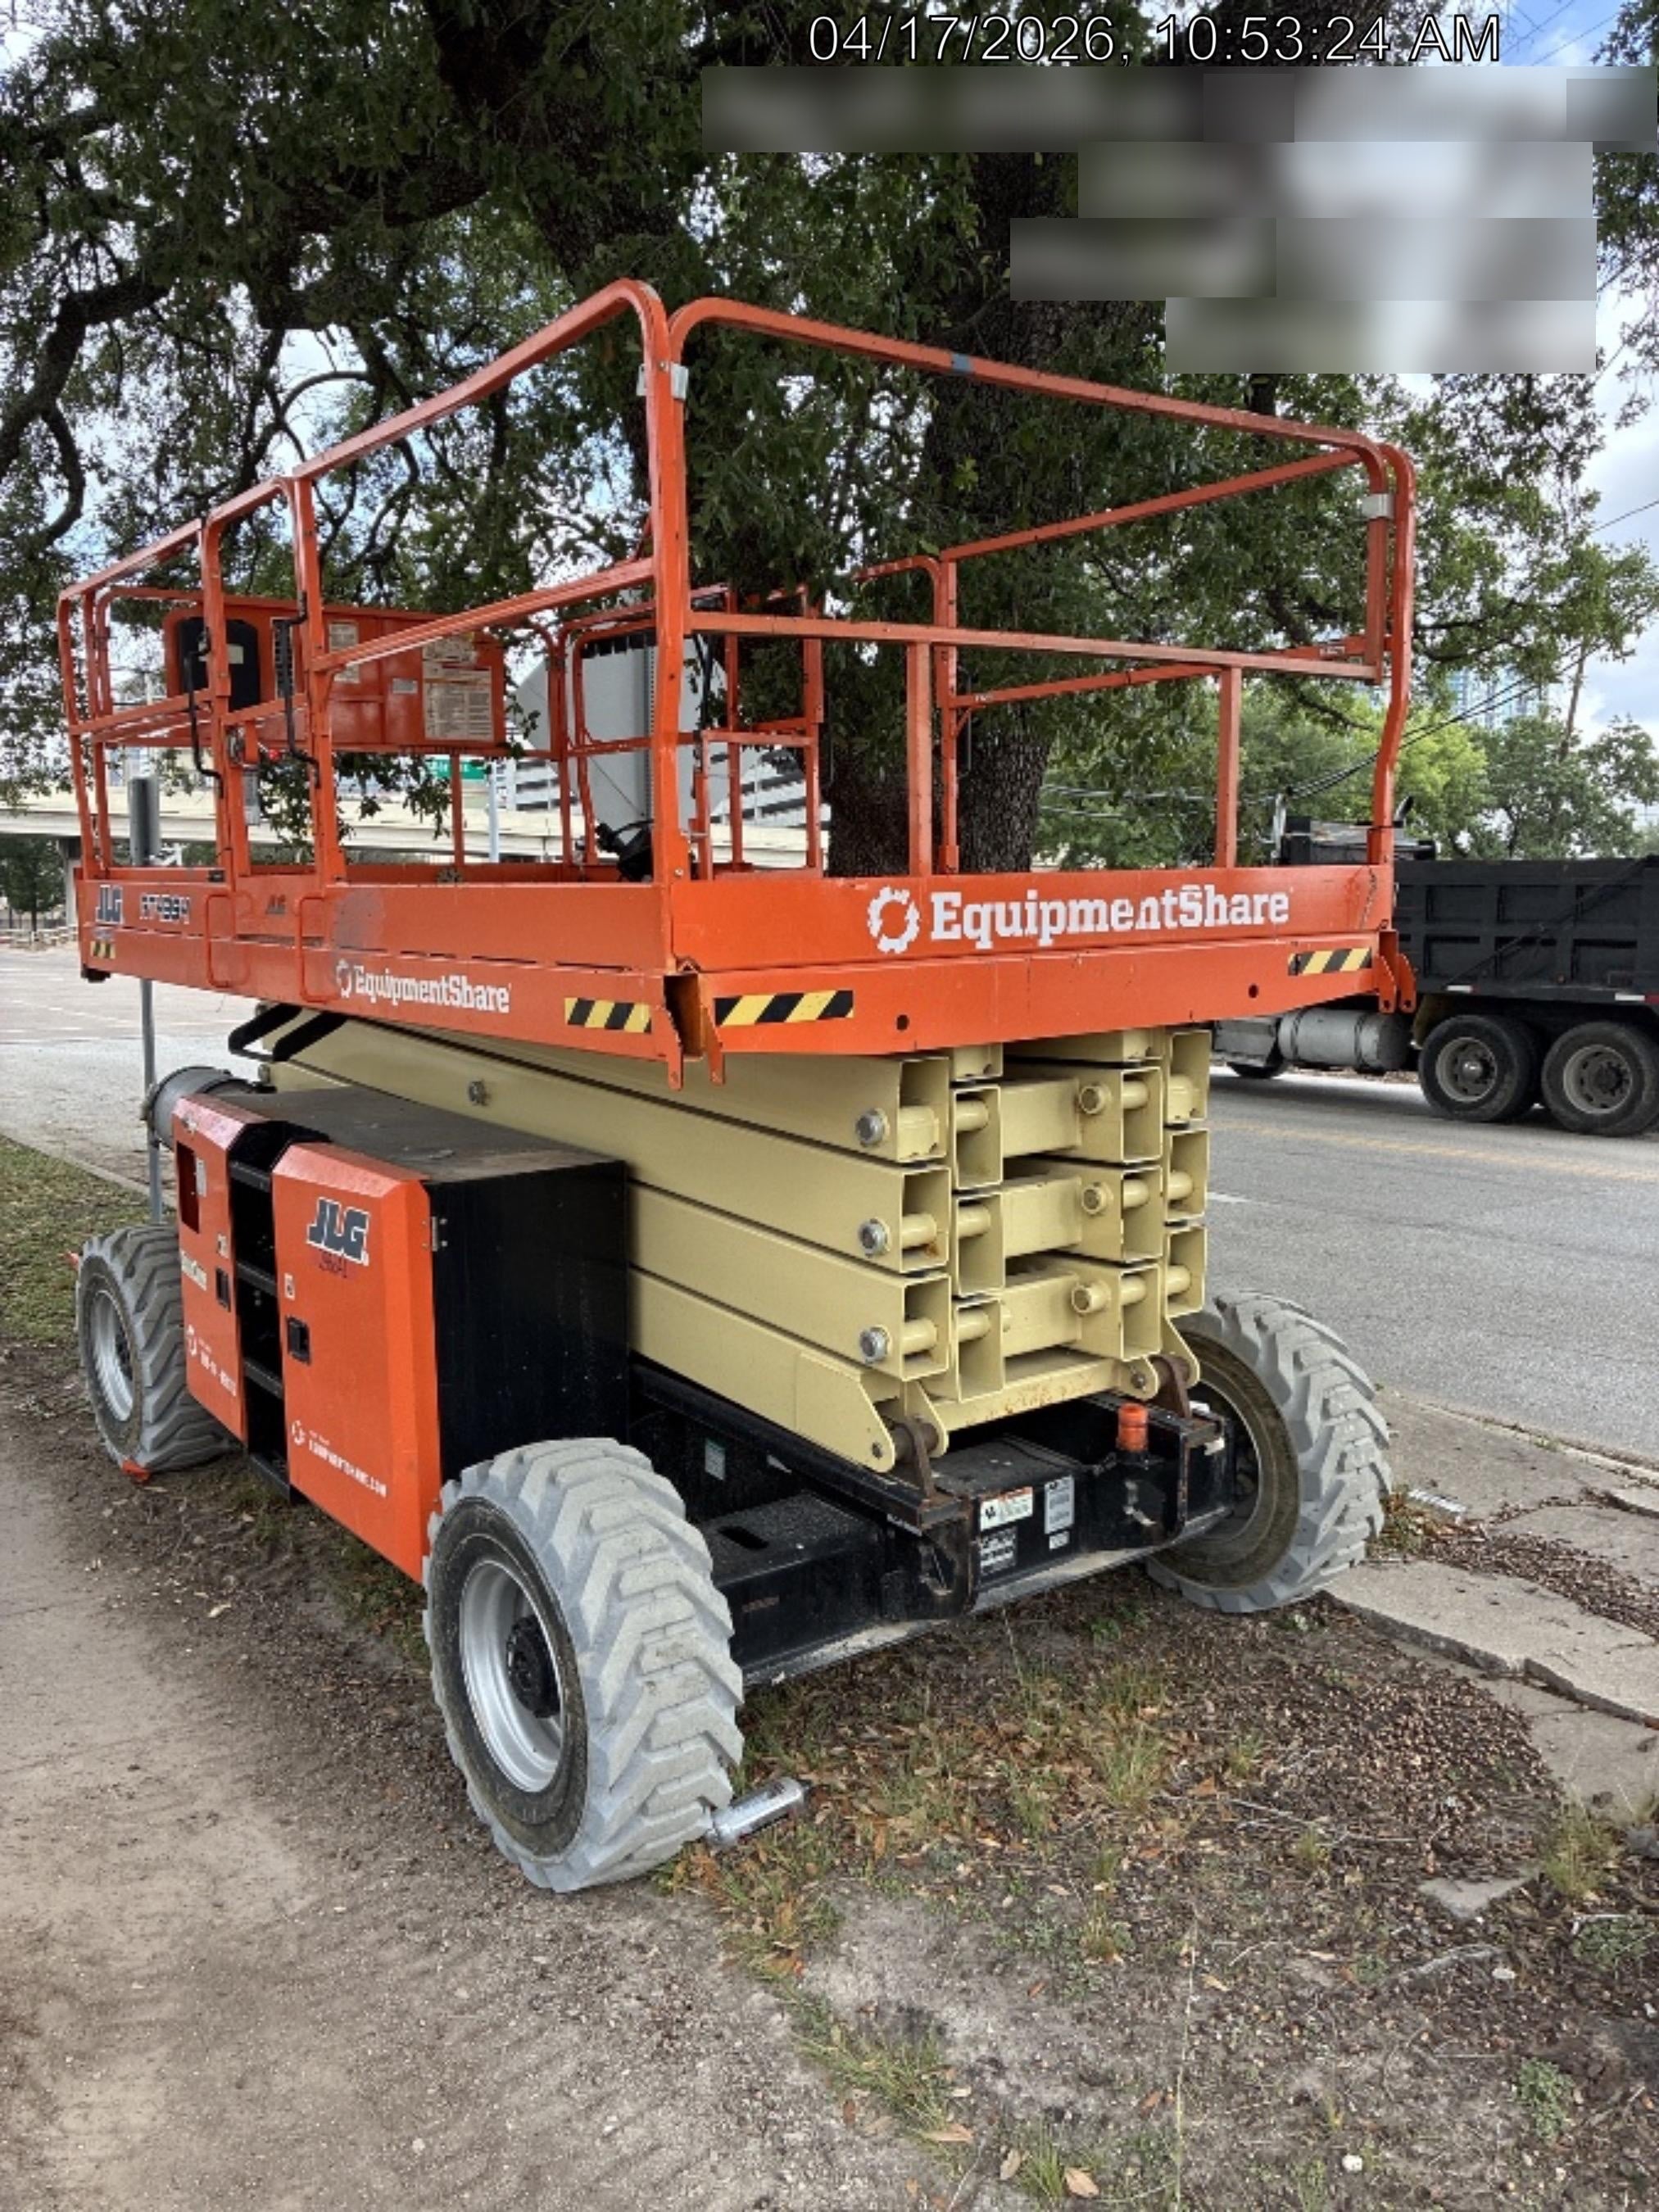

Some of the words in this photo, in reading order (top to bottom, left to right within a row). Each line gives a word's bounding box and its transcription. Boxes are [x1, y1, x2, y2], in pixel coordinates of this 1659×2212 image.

[930, 885, 1290, 949] EquipmentShare
[354, 965, 510, 1013] EquipmentShare
[306, 1197, 369, 1267] JLG
